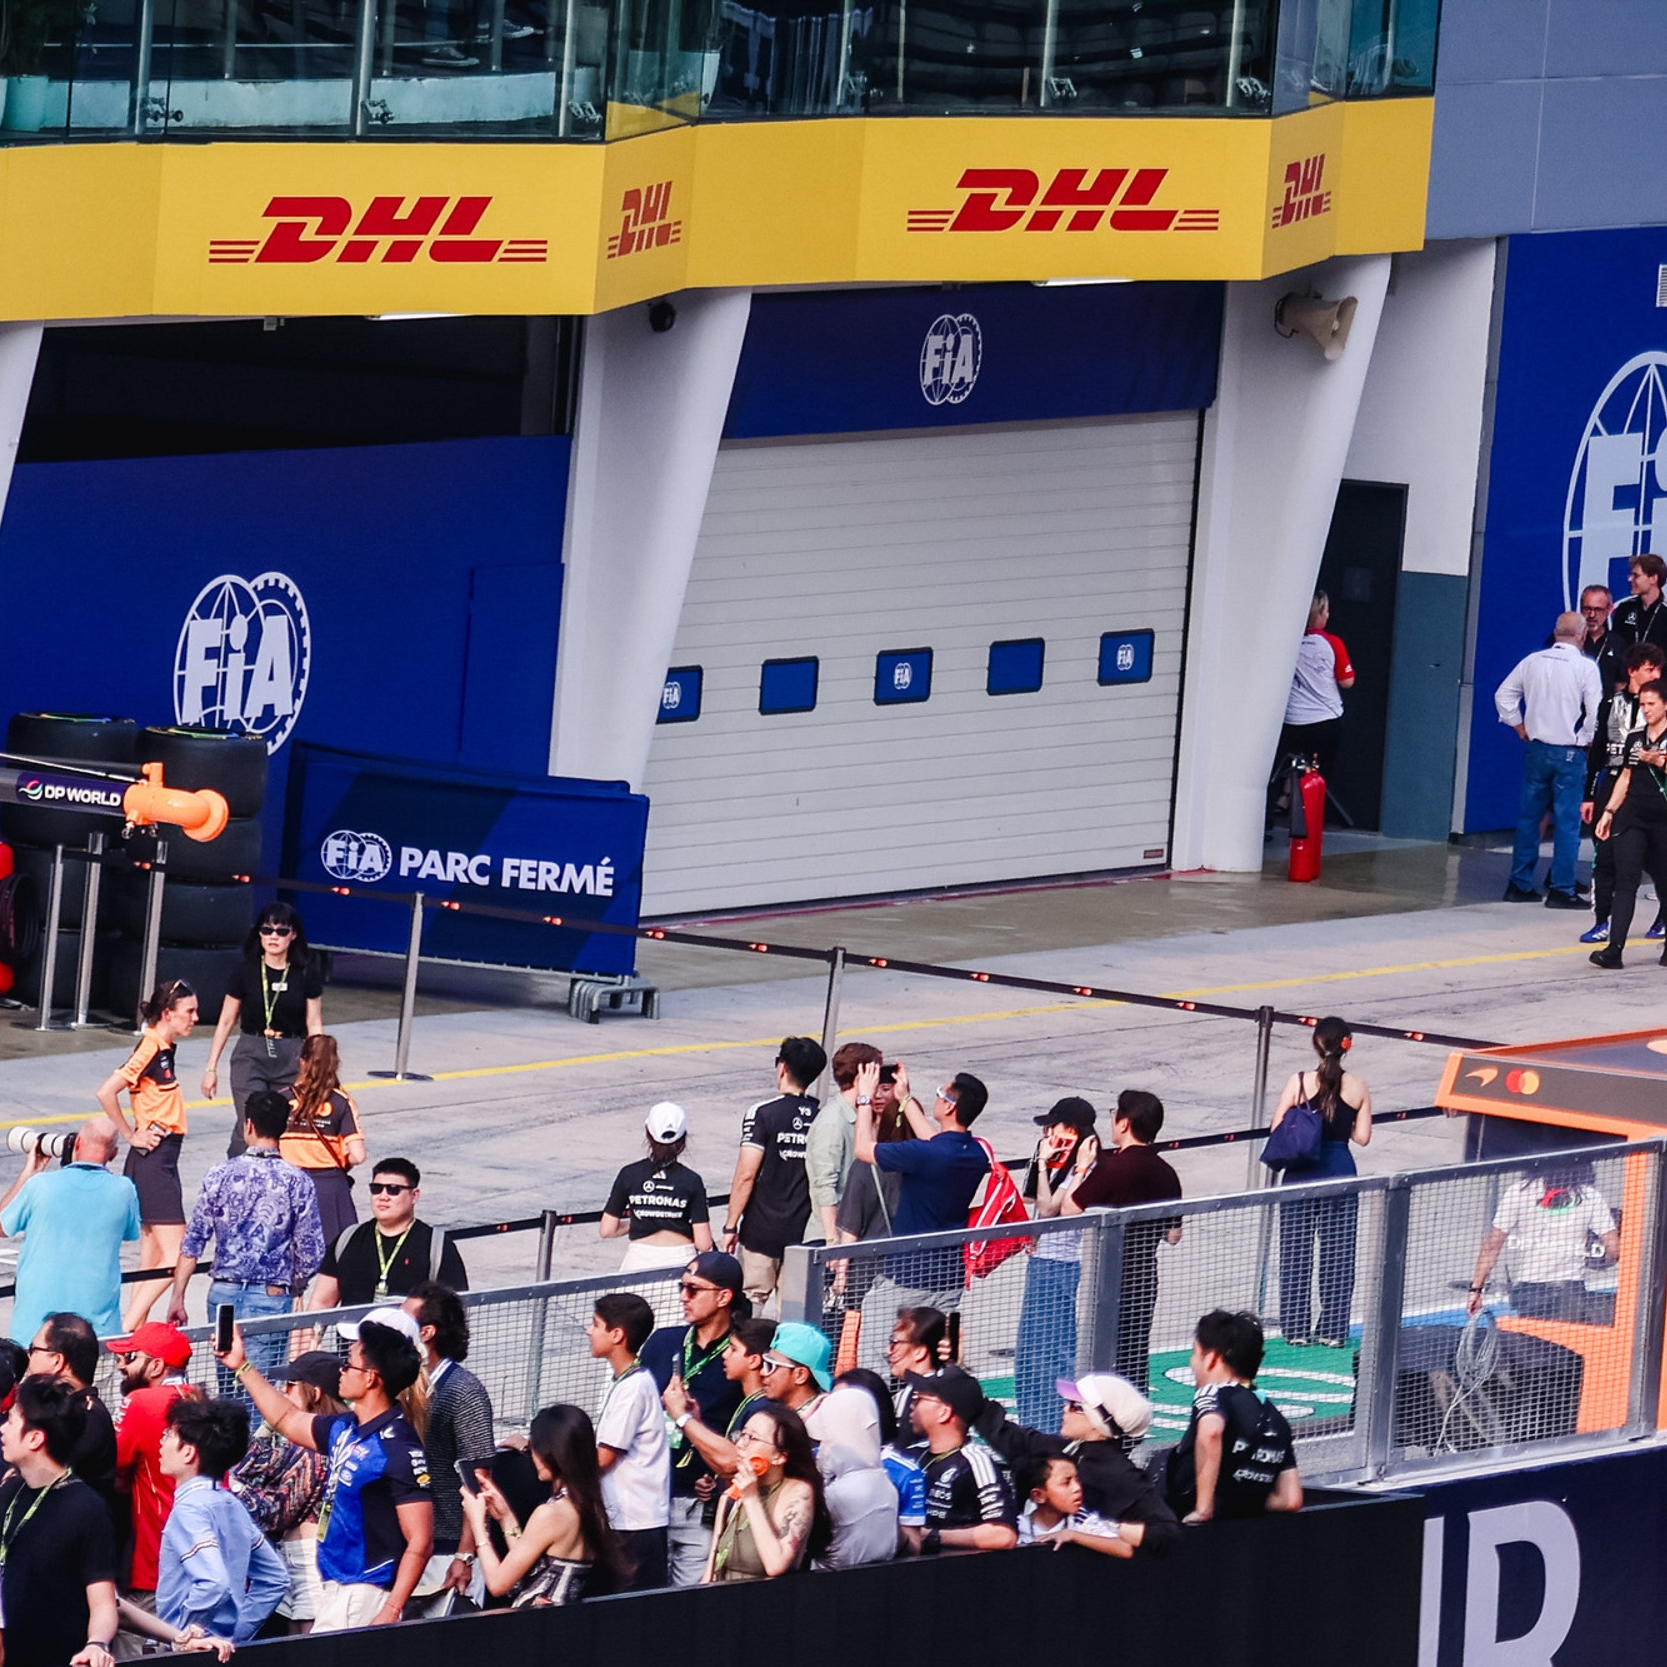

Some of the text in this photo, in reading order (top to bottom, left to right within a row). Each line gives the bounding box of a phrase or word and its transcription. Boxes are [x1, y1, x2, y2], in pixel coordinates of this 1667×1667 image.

[616, 181, 673, 255] DHL
[949, 168, 1179, 232] DHL
[1280, 153, 1325, 226] DHL
[255, 196, 503, 263] DHL
[44, 785, 120, 807] DP WORLD
[400, 846, 490, 886] PARC
[502, 857, 614, 897] FERMÉ
[776, 1132, 807, 1145] PETR
[629, 1195, 687, 1208] PETRONAS
